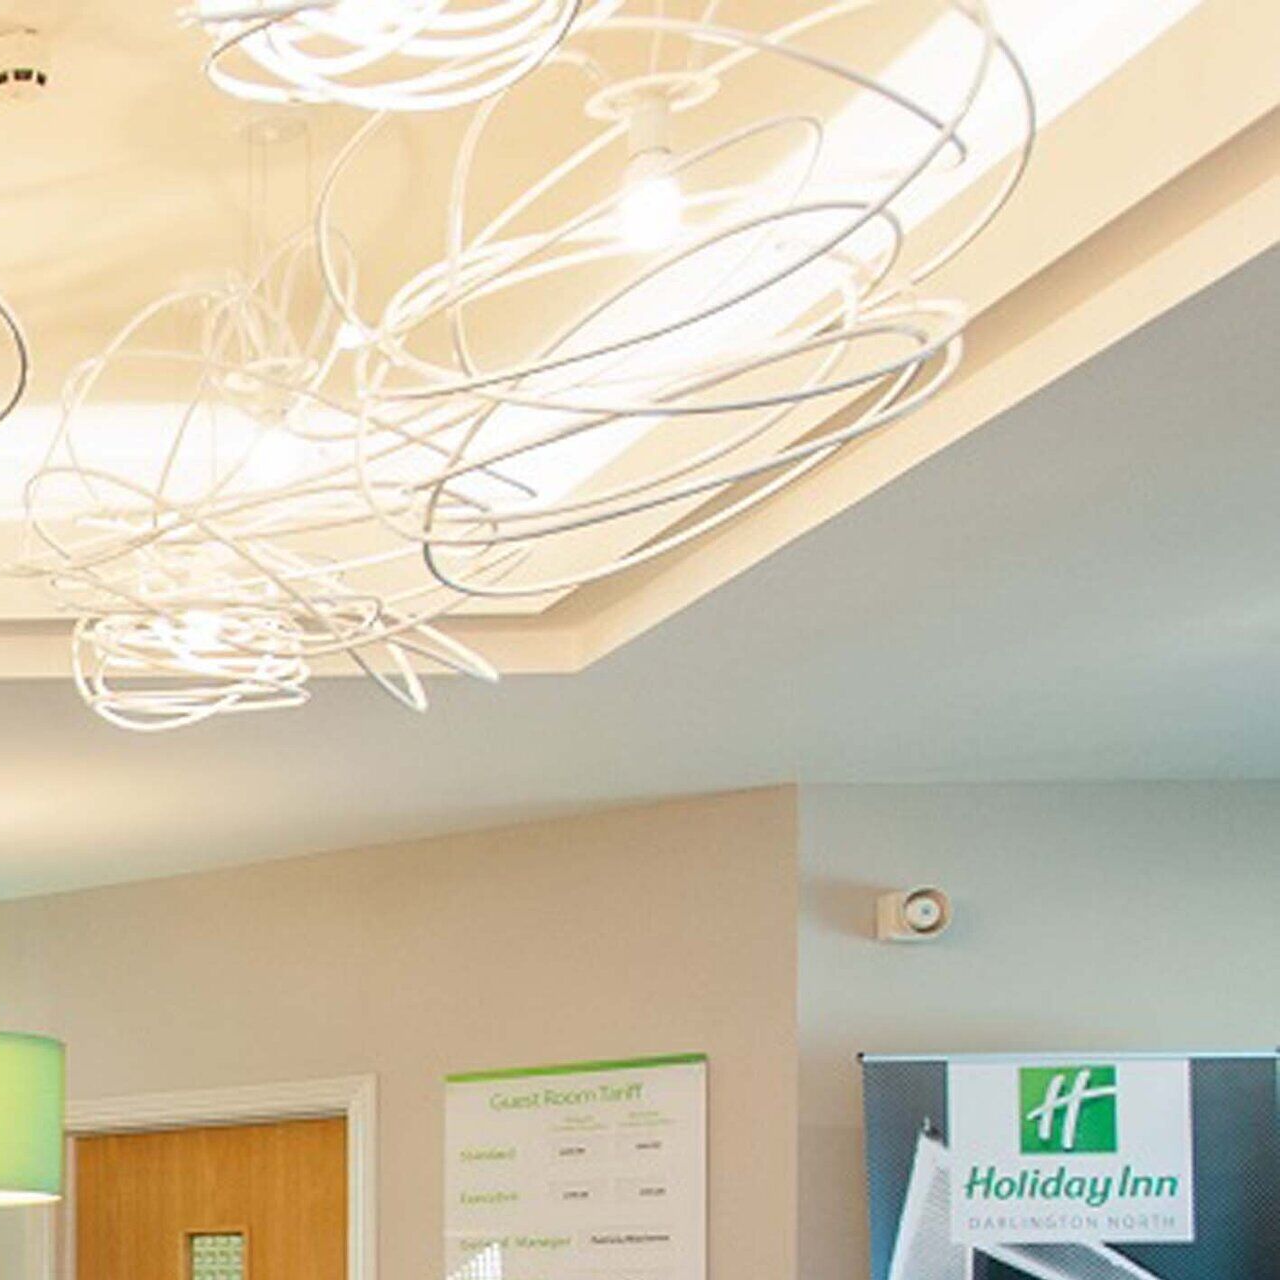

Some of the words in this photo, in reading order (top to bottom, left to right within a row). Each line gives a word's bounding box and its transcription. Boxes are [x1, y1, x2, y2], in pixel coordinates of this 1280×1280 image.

[490, 1092, 540, 1112] Guest
[544, 1089, 596, 1106] Room
[599, 1082, 645, 1101] Tariff
[964, 1166, 1112, 1207] Holiday
[1118, 1165, 1178, 1198] Inn
[969, 1216, 1098, 1230] DARLINGTON
[1107, 1214, 1176, 1229] NORTH
